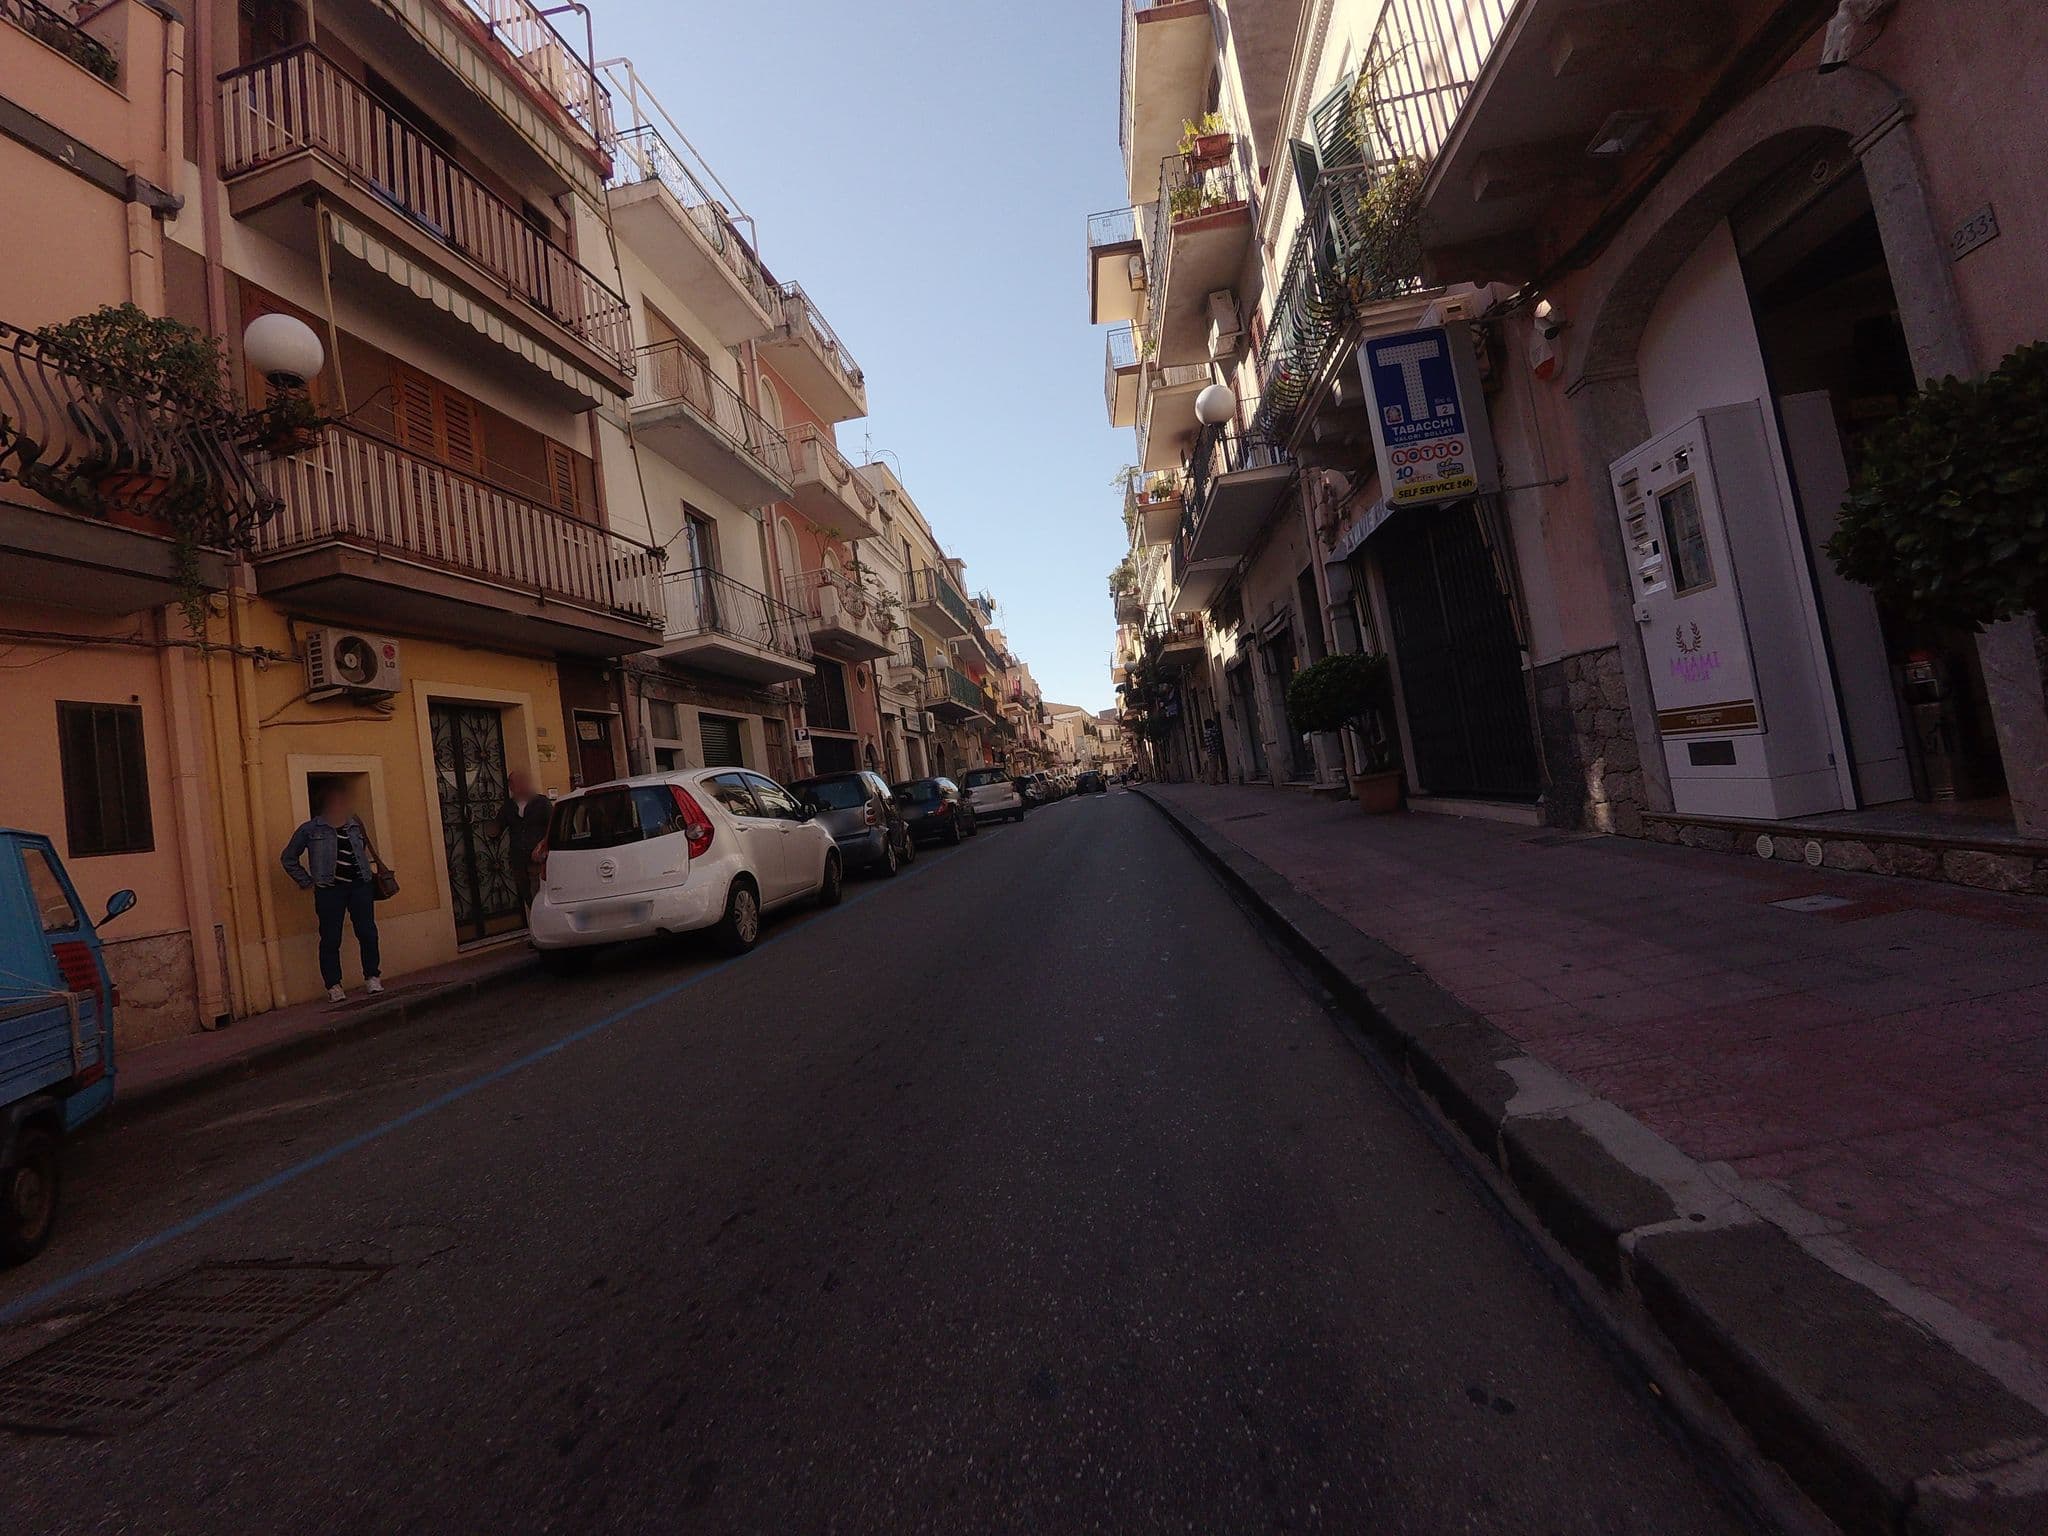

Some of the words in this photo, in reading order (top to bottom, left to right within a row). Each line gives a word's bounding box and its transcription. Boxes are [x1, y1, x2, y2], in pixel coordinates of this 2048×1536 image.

[1954, 215, 1989, 250] 233
[1376, 339, 1440, 421] T
[1392, 417, 1454, 437] TABACCHI
[1394, 433, 1421, 443] VALORI
[1392, 441, 1464, 465] LOTTO
[1396, 465, 1413, 480] 10
[1398, 488, 1418, 499] SELF
[1419, 481, 1455, 495] SERVICE
[385, 660, 395, 669] LG
[798, 729, 807, 741] P
